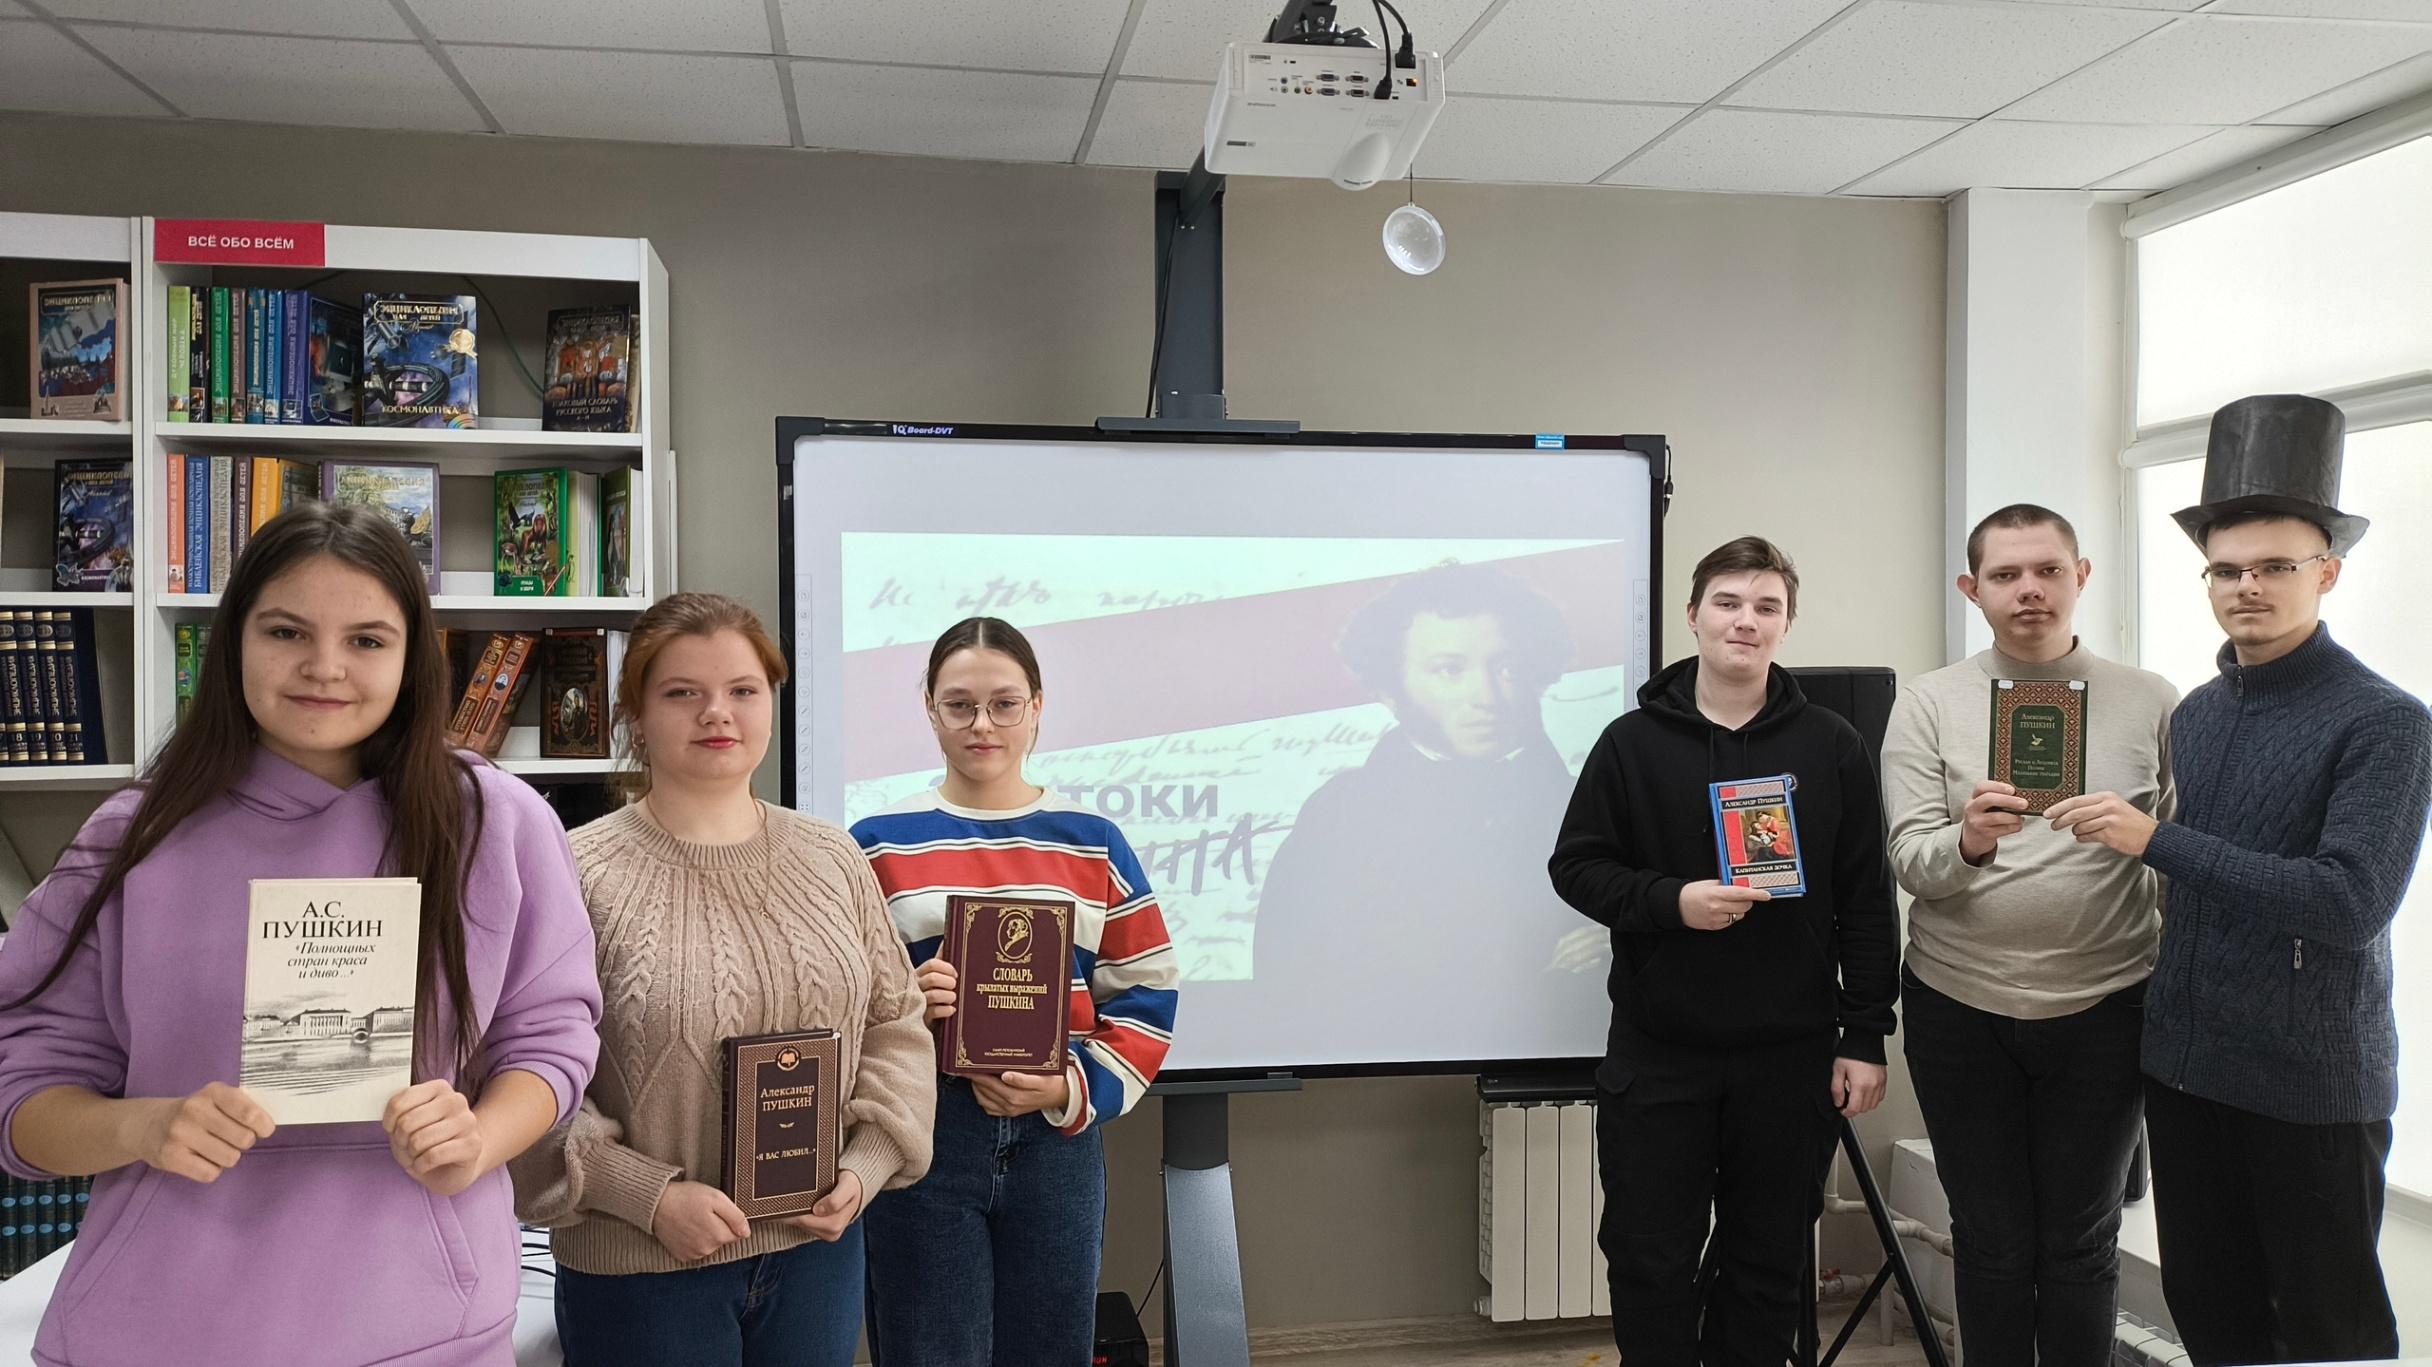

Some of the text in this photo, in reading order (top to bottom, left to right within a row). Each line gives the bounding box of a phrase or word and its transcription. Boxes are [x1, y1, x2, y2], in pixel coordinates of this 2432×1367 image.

[188, 235, 294, 249] ВСЁ ОБО ВСЁМ
[381, 405, 459, 415] КОСМОНАВТИКА
[194, 462, 203, 588] БИБЛЕЙСКАЯ ЭНЦИКЛОПЕДИЯ
[7, 656, 22, 717] ЭНЦИКЛОПЕДИЯ
[27, 656, 41, 716] ЭНЦИКЛОПЕДИЯ
[46, 656, 60, 717] ЭНЦИКЛОПЕДИЯ
[2020, 721, 2056, 729] ПУШКИН
[302, 901, 345, 919] А.С.
[262, 919, 384, 939] ПУШКИН
[287, 955, 368, 969] стран краса
[298, 970, 306, 979] и
[992, 967, 1033, 982] СЛОВАРЬ
[976, 983, 1048, 996] крылатых выражений
[988, 995, 1035, 1010] ПУШКИНА
[760, 1084, 815, 1098] Александр
[762, 1096, 812, 1112] ПУШКИН
[765, 1151, 780, 1160] ВАС
